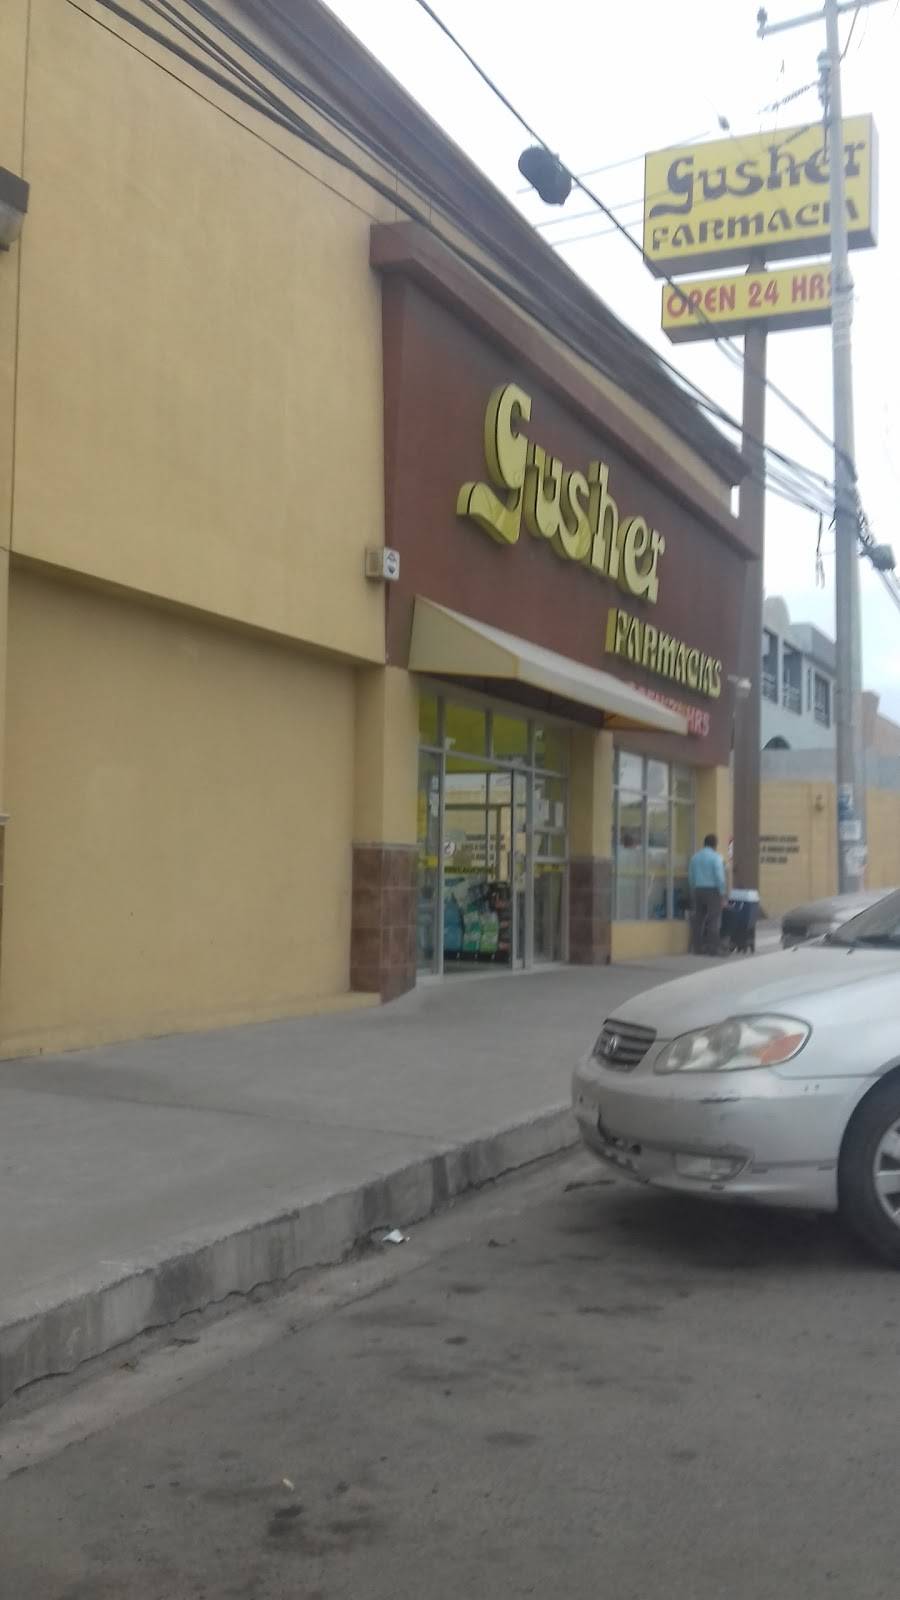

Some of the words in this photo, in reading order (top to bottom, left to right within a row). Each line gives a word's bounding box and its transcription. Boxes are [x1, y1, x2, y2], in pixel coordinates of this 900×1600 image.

[666, 284, 736, 318] OPEN
[749, 280, 779, 308] 24
[456, 382, 666, 605] Gusher
[605, 607, 723, 698] FARMACIAS
